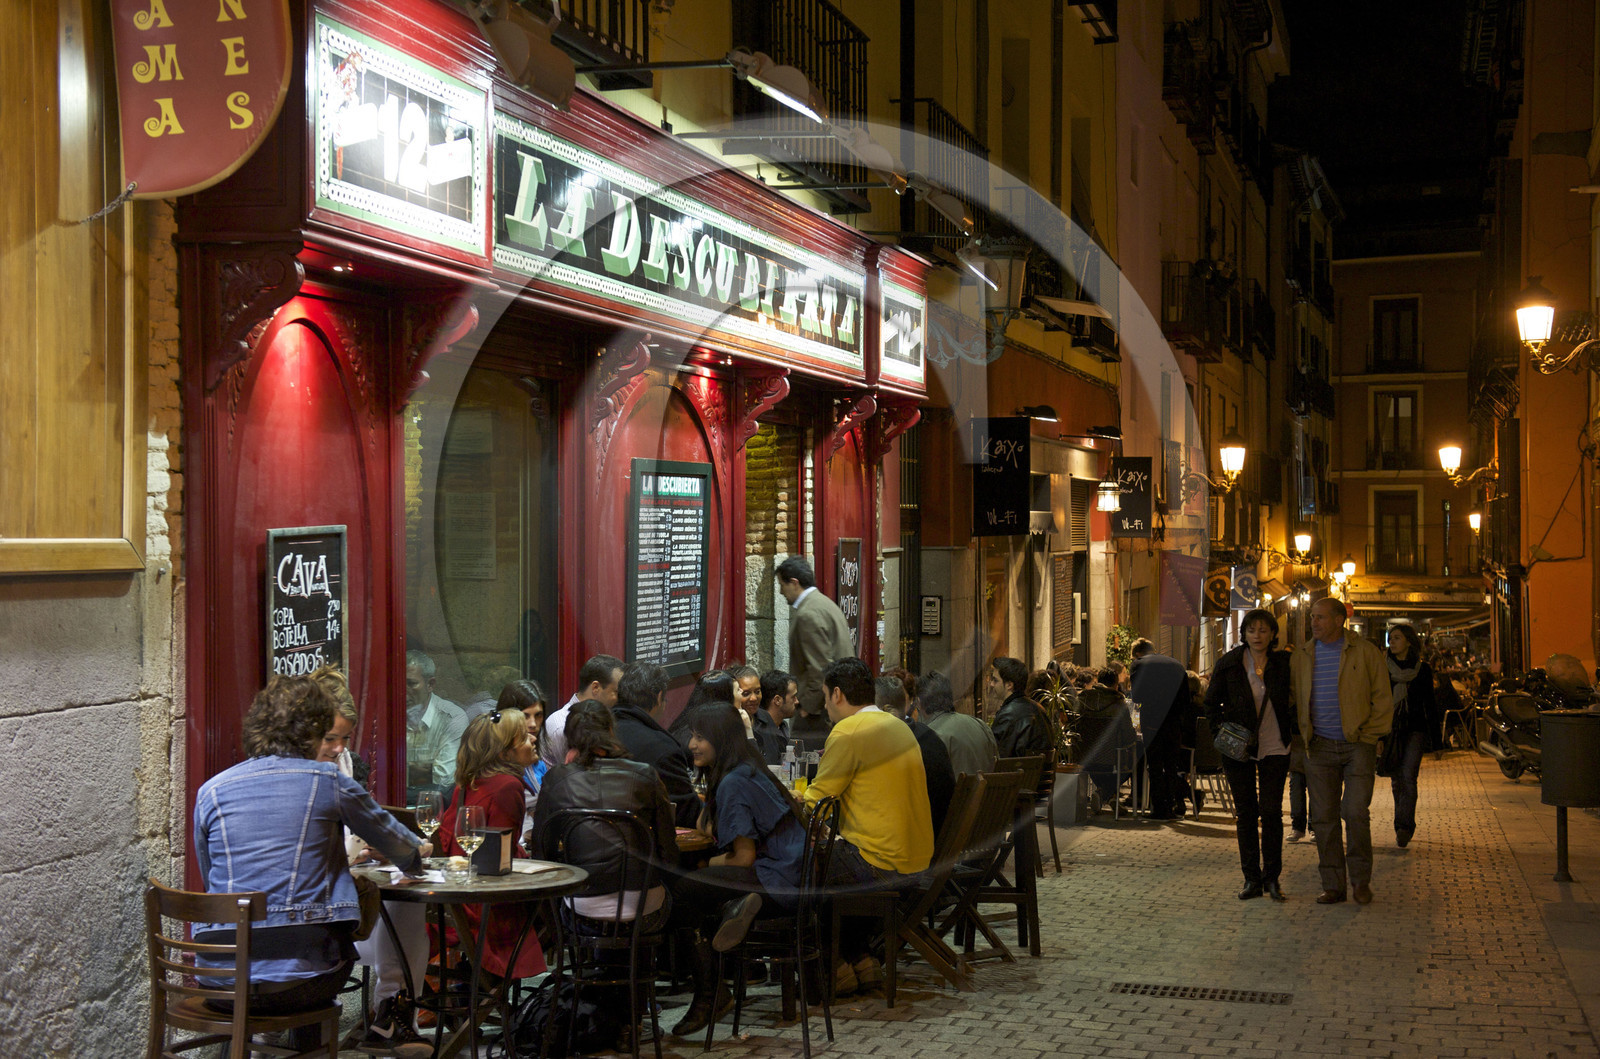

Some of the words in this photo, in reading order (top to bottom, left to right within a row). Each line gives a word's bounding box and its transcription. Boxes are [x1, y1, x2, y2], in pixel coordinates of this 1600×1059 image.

[504, 150, 596, 257] LA
[601, 190, 858, 345] DESCUBIERTA
[642, 475, 653, 495] LA
[657, 476, 700, 497] DESCUBIERTA
[277, 552, 332, 598] CAVA
[273, 607, 295, 627] COPA
[273, 623, 309, 649] BOTELLA
